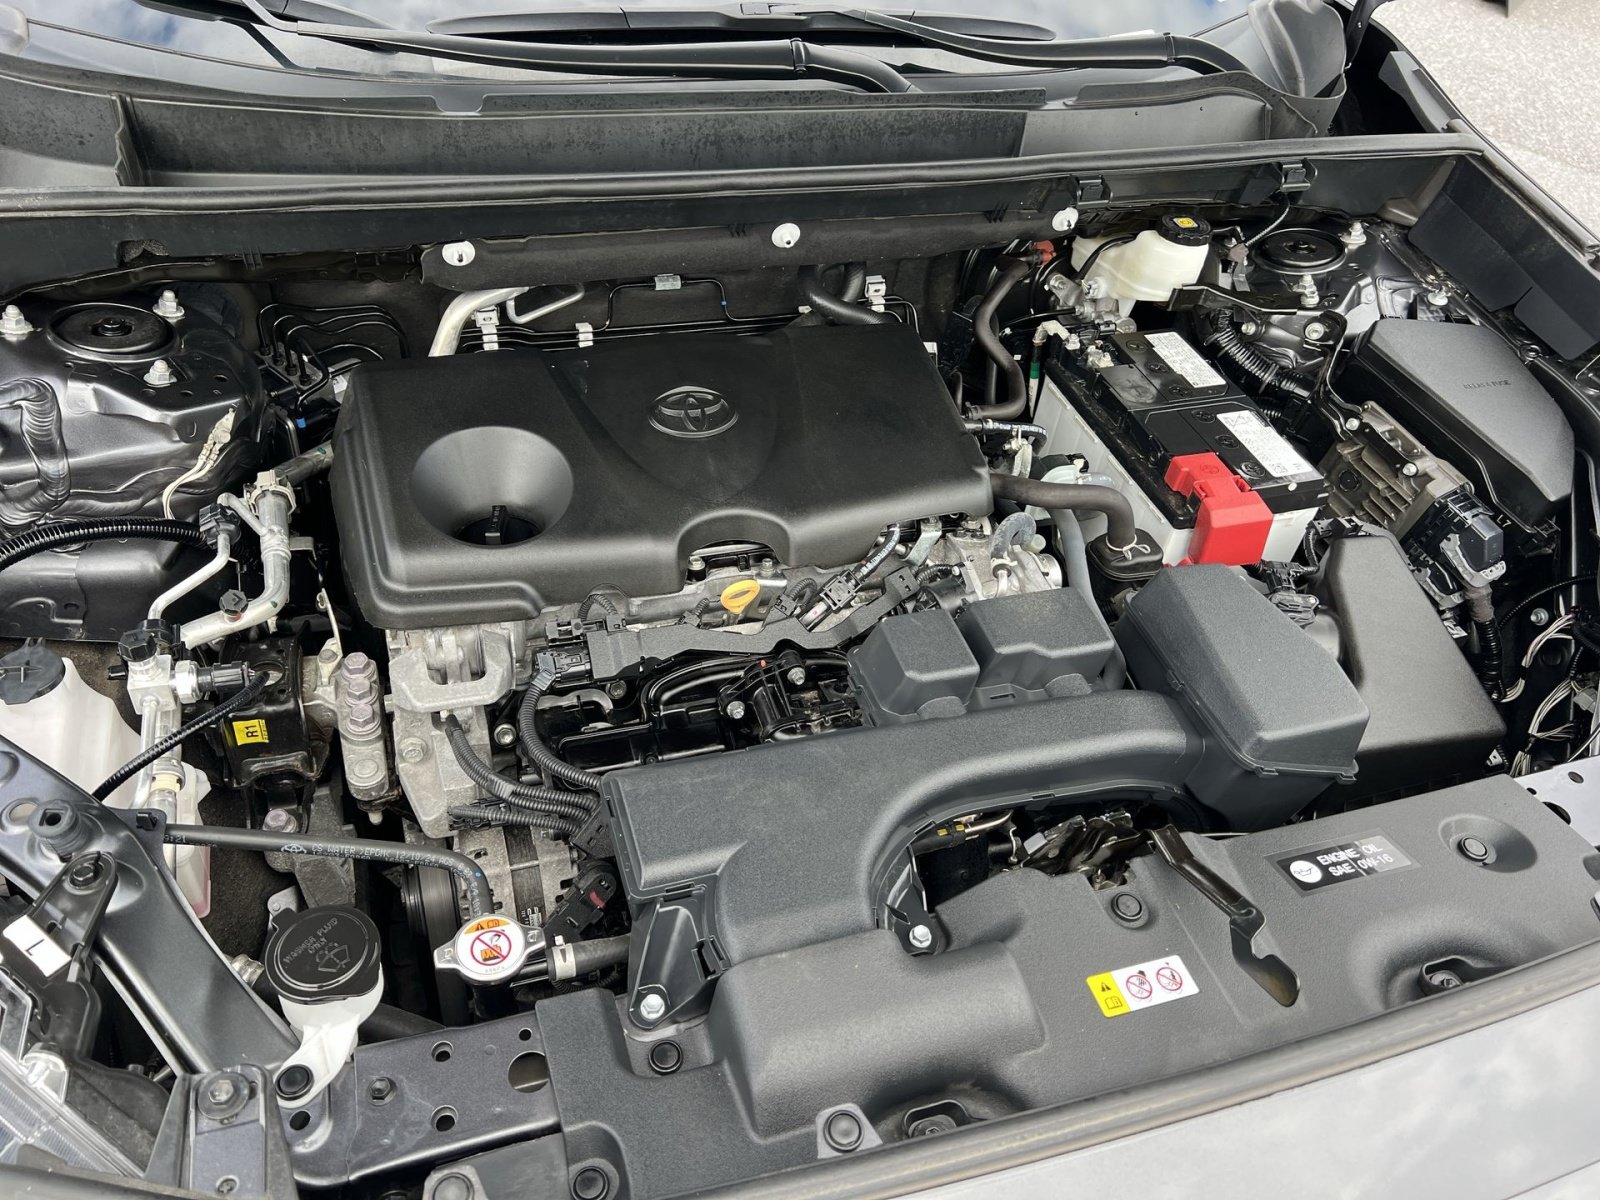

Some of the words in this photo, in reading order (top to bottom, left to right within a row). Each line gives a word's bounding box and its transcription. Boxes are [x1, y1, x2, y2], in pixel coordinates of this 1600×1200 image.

[244, 725, 260, 738] R1
[327, 844, 356, 855] WATER
[1316, 848, 1360, 866] ENGINE
[1361, 843, 1384, 855] OIL
[1328, 862, 1356, 877] SAE
[1356, 853, 1394, 870] 0W-16
[283, 935, 317, 964] WASHER
